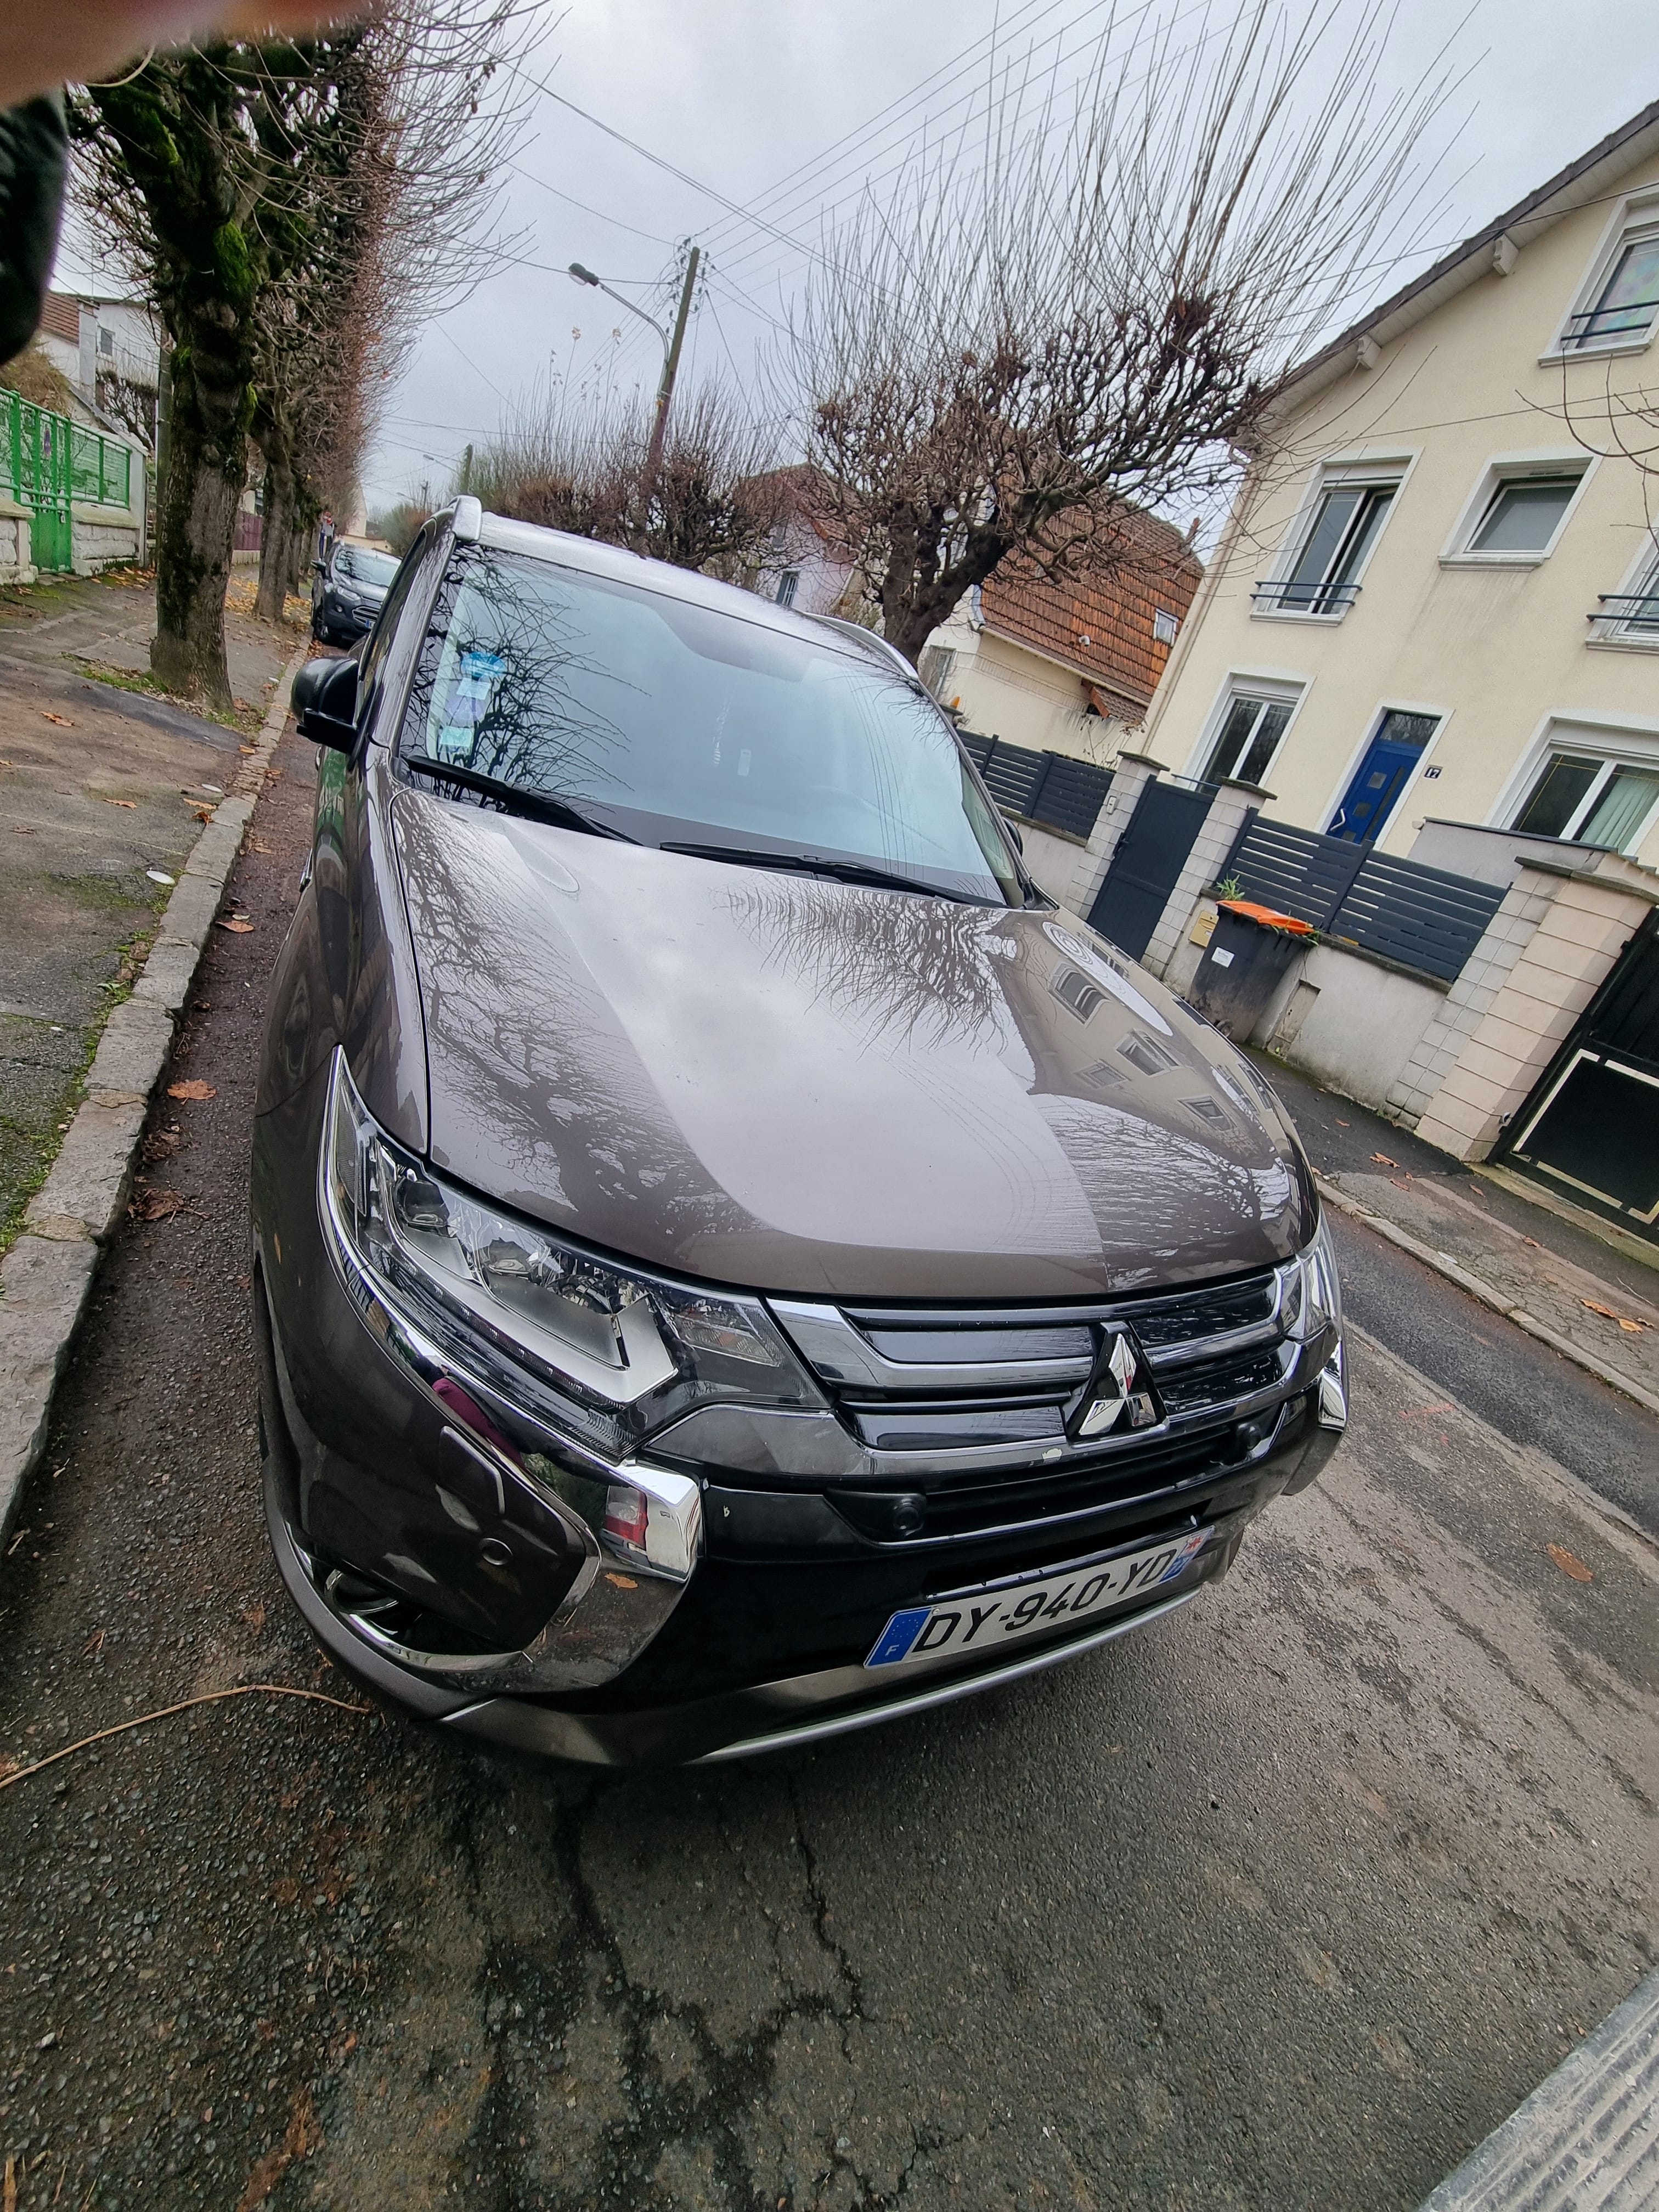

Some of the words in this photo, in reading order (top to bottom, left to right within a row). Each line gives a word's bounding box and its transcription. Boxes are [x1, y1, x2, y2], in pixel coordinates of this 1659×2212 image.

[1426, 768, 1440, 778] 17
[884, 1644, 900, 1656] F
[911, 1548, 1177, 1652] DY-940-YD
